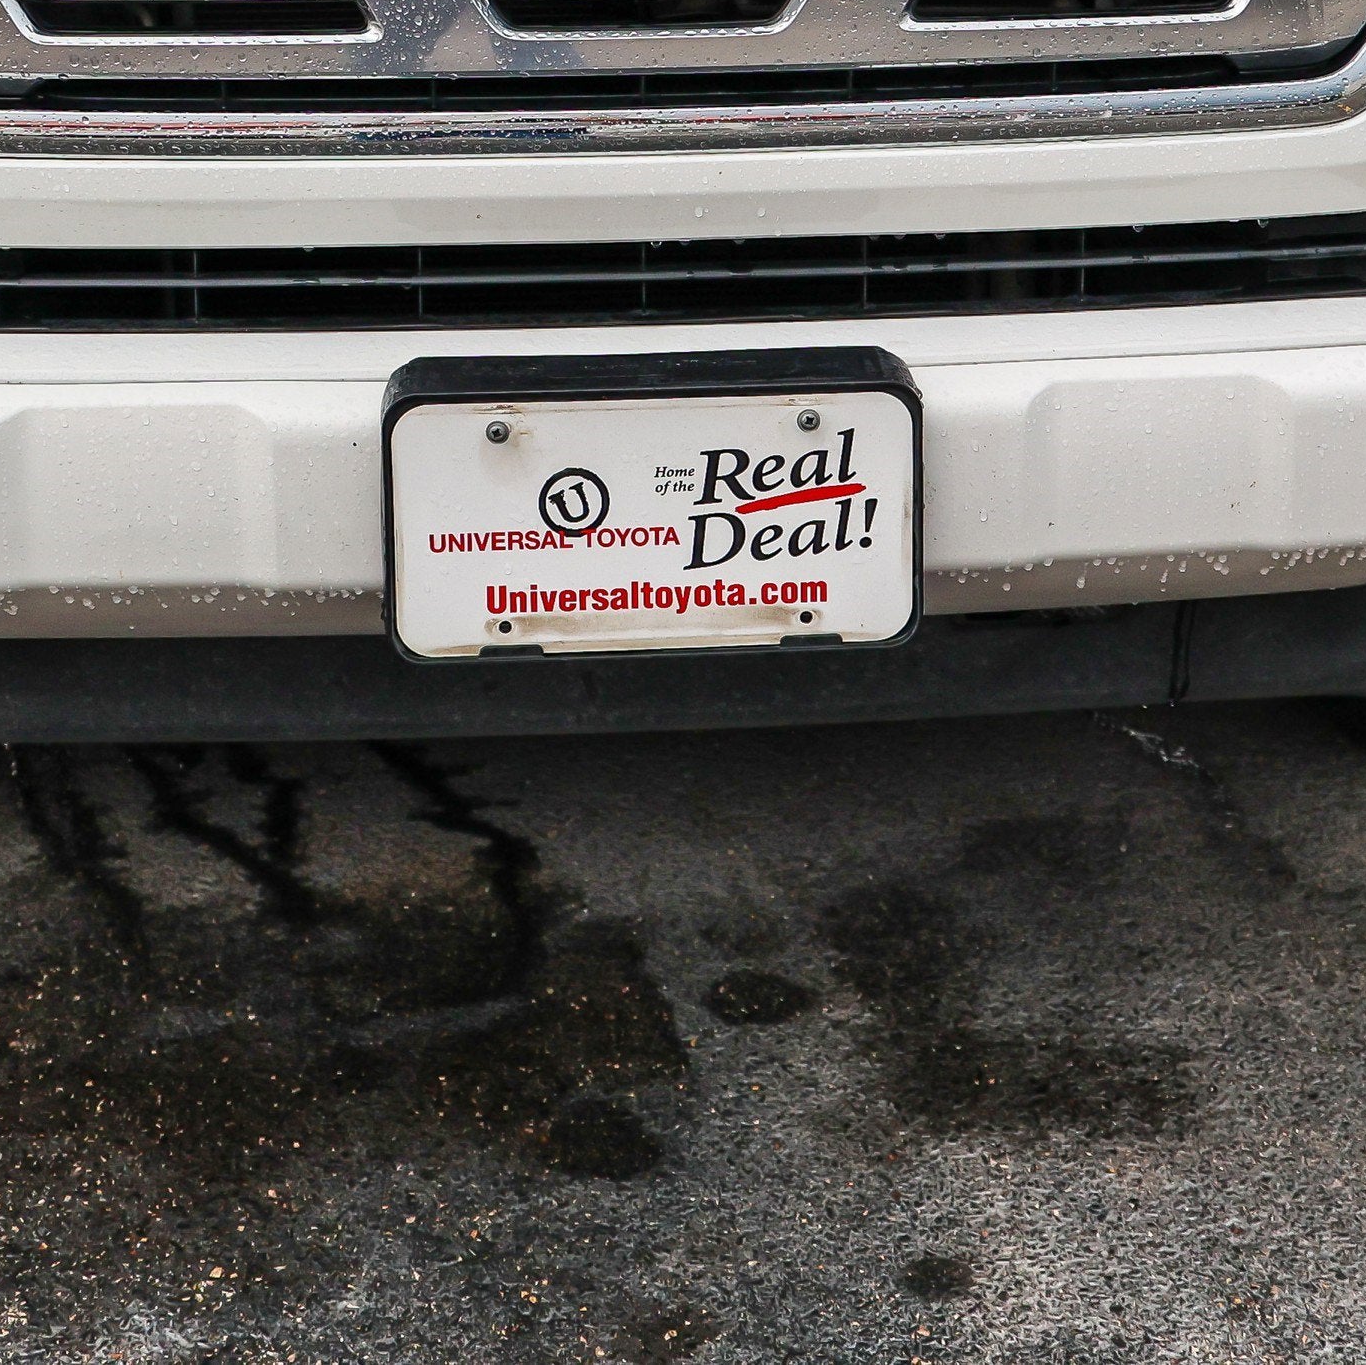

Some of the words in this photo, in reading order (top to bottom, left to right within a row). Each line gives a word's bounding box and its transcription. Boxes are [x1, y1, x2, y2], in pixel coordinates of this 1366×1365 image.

[654, 466, 695, 478] Home
[693, 428, 856, 505] Real
[655, 480, 672, 496] of
[673, 480, 695, 493] the
[428, 530, 574, 553] UNIVERSAL
[581, 526, 681, 548] TOYOTA
[683, 498, 878, 570] Deal!
[486, 579, 828, 615] Universaltoyota.com
